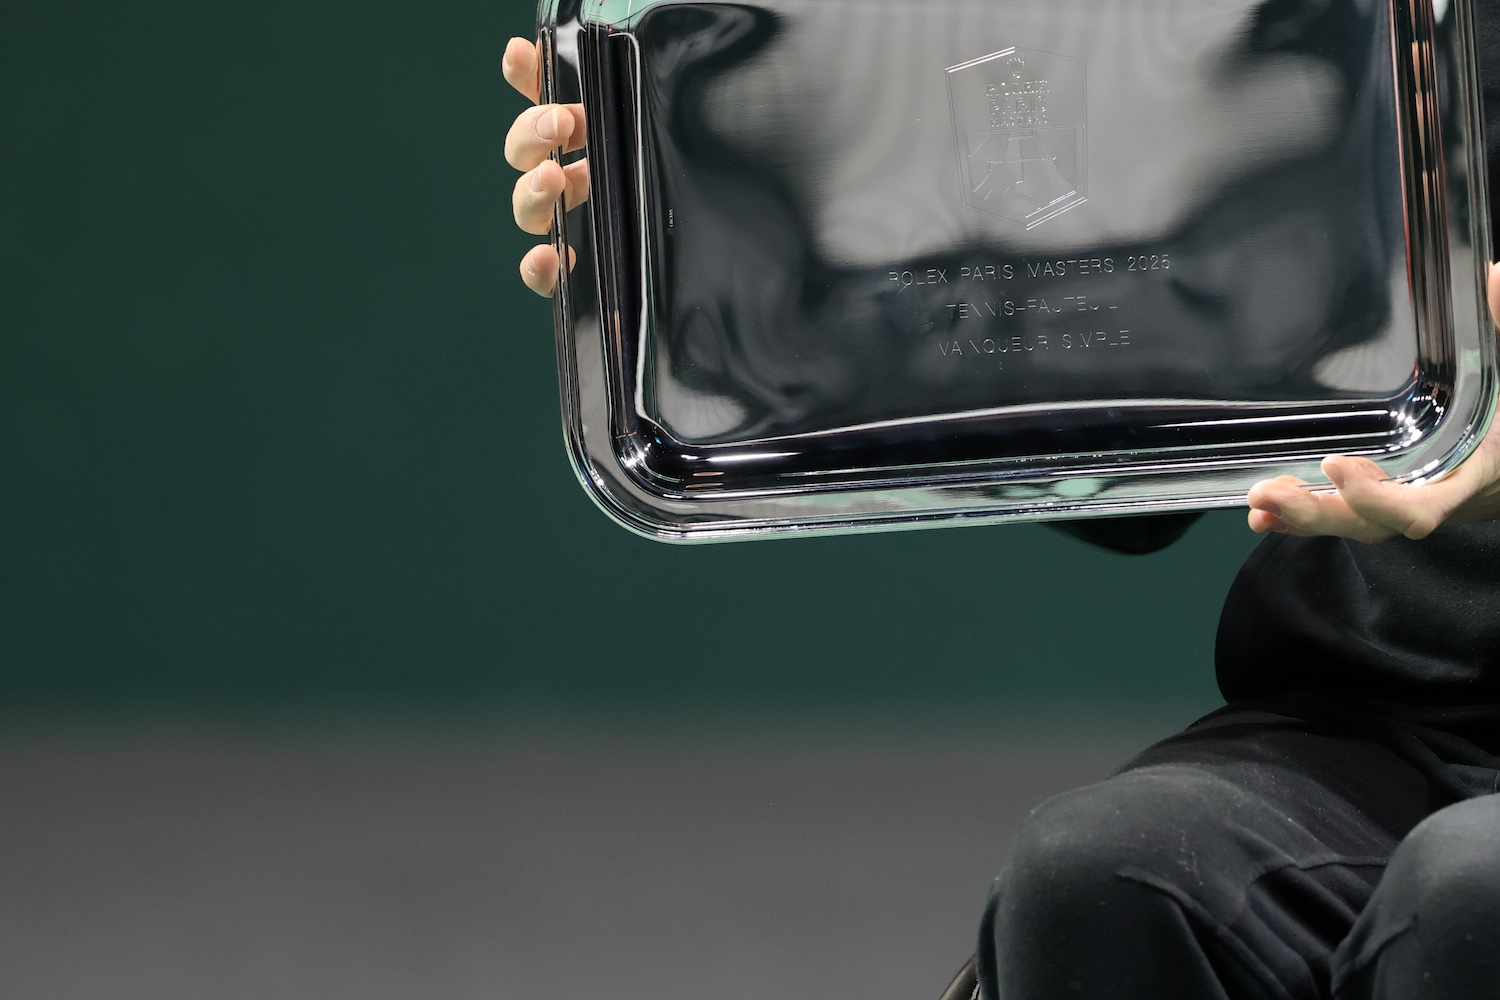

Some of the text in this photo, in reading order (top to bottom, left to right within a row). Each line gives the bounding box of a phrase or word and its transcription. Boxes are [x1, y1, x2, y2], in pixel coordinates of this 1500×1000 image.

[986, 80, 1050, 96] ROLEX
[989, 95, 1047, 115] PARIS
[888, 254, 1171, 287] ROLEX PARIS MASTERS 2025
[946, 295, 1118, 320] TENNIS-FAUTEU
[938, 329, 1131, 357] VANQUEUR SMPE
